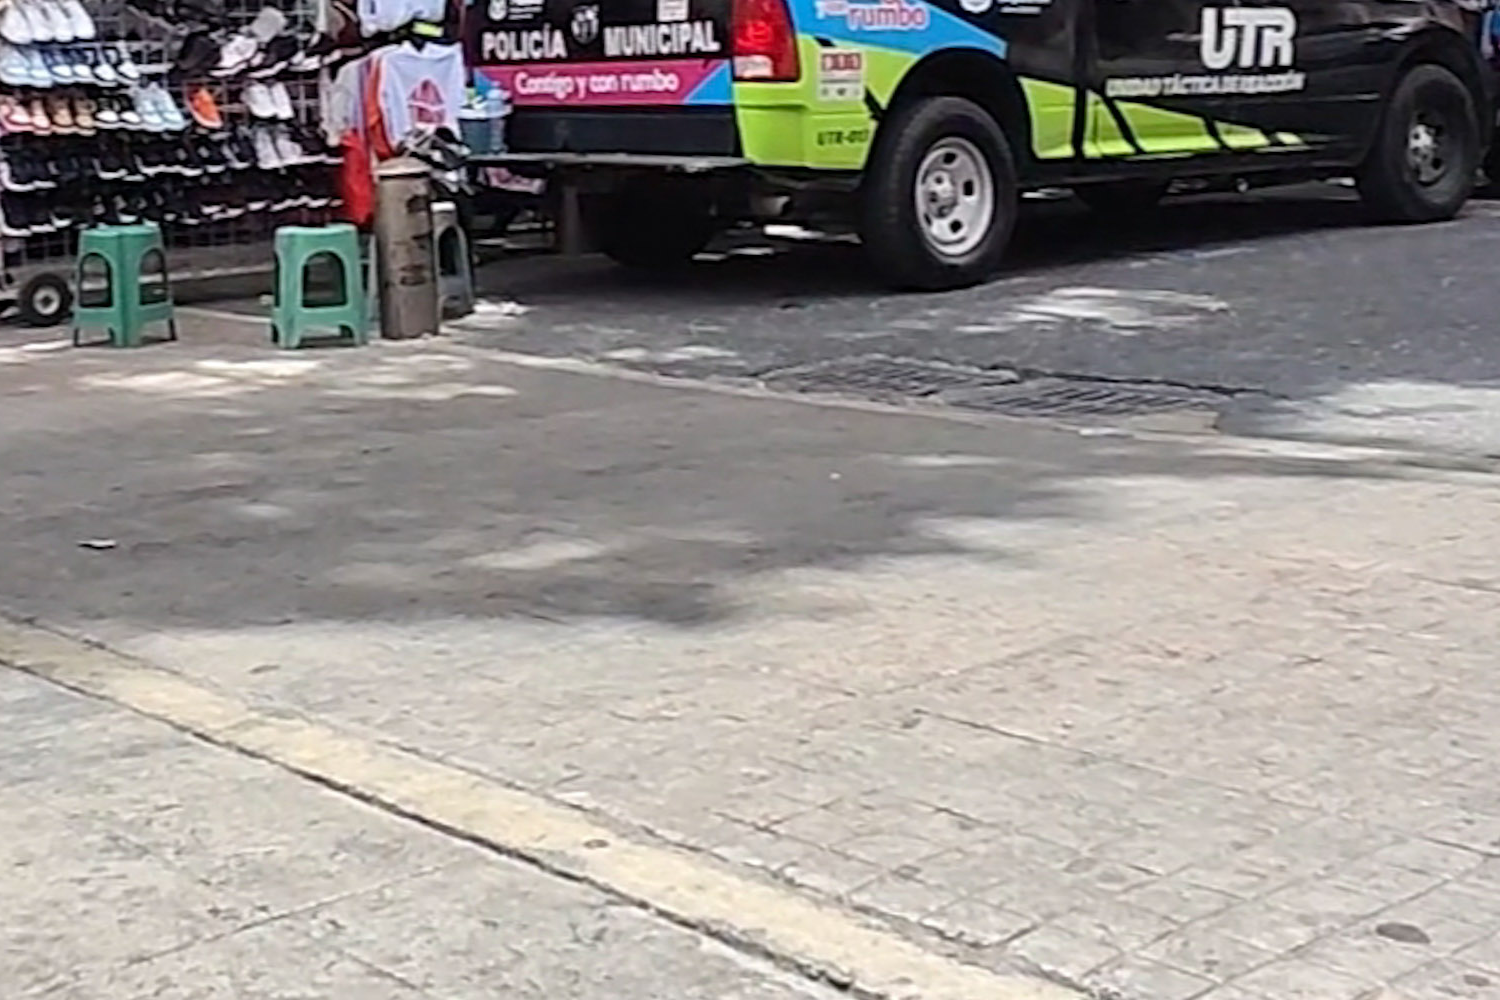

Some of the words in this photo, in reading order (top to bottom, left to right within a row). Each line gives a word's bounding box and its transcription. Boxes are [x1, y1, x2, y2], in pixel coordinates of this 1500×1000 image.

[482, 23, 567, 60] POLICÍA
[603, 20, 721, 57] MUNICIPAL
[1201, 7, 1297, 69] UTR
[515, 71, 574, 99] Contigo
[573, 75, 586, 98] y
[589, 75, 618, 92] con
[621, 68, 680, 92] rumbo
